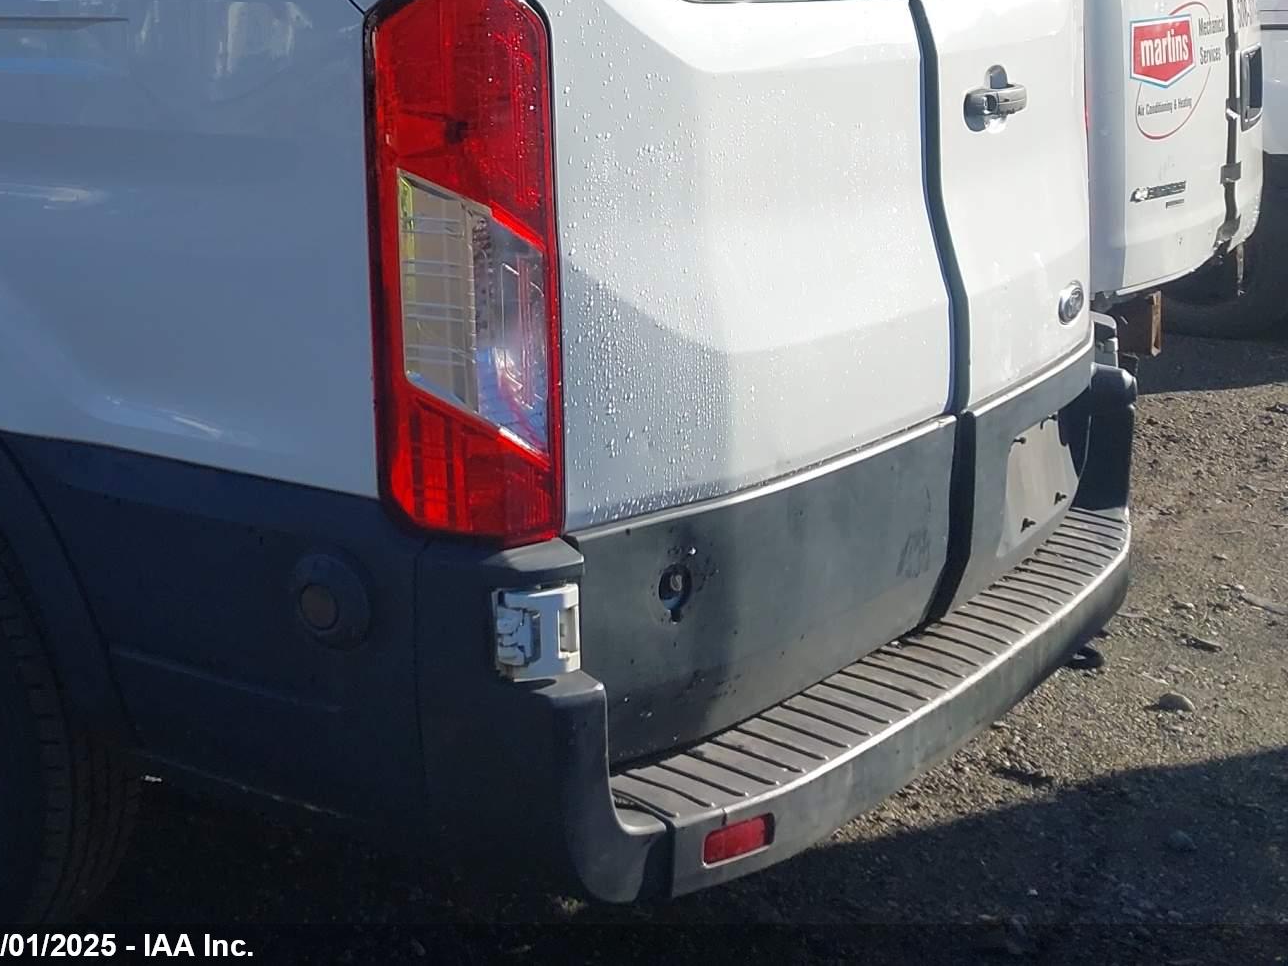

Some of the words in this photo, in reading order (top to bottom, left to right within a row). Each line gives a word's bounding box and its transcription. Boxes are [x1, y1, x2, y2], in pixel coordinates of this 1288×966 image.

[1198, 14, 1226, 36] Mechanical
[1140, 28, 1189, 67] martins
[1199, 45, 1221, 65] Services
[1145, 100, 1172, 114] Conditioning
